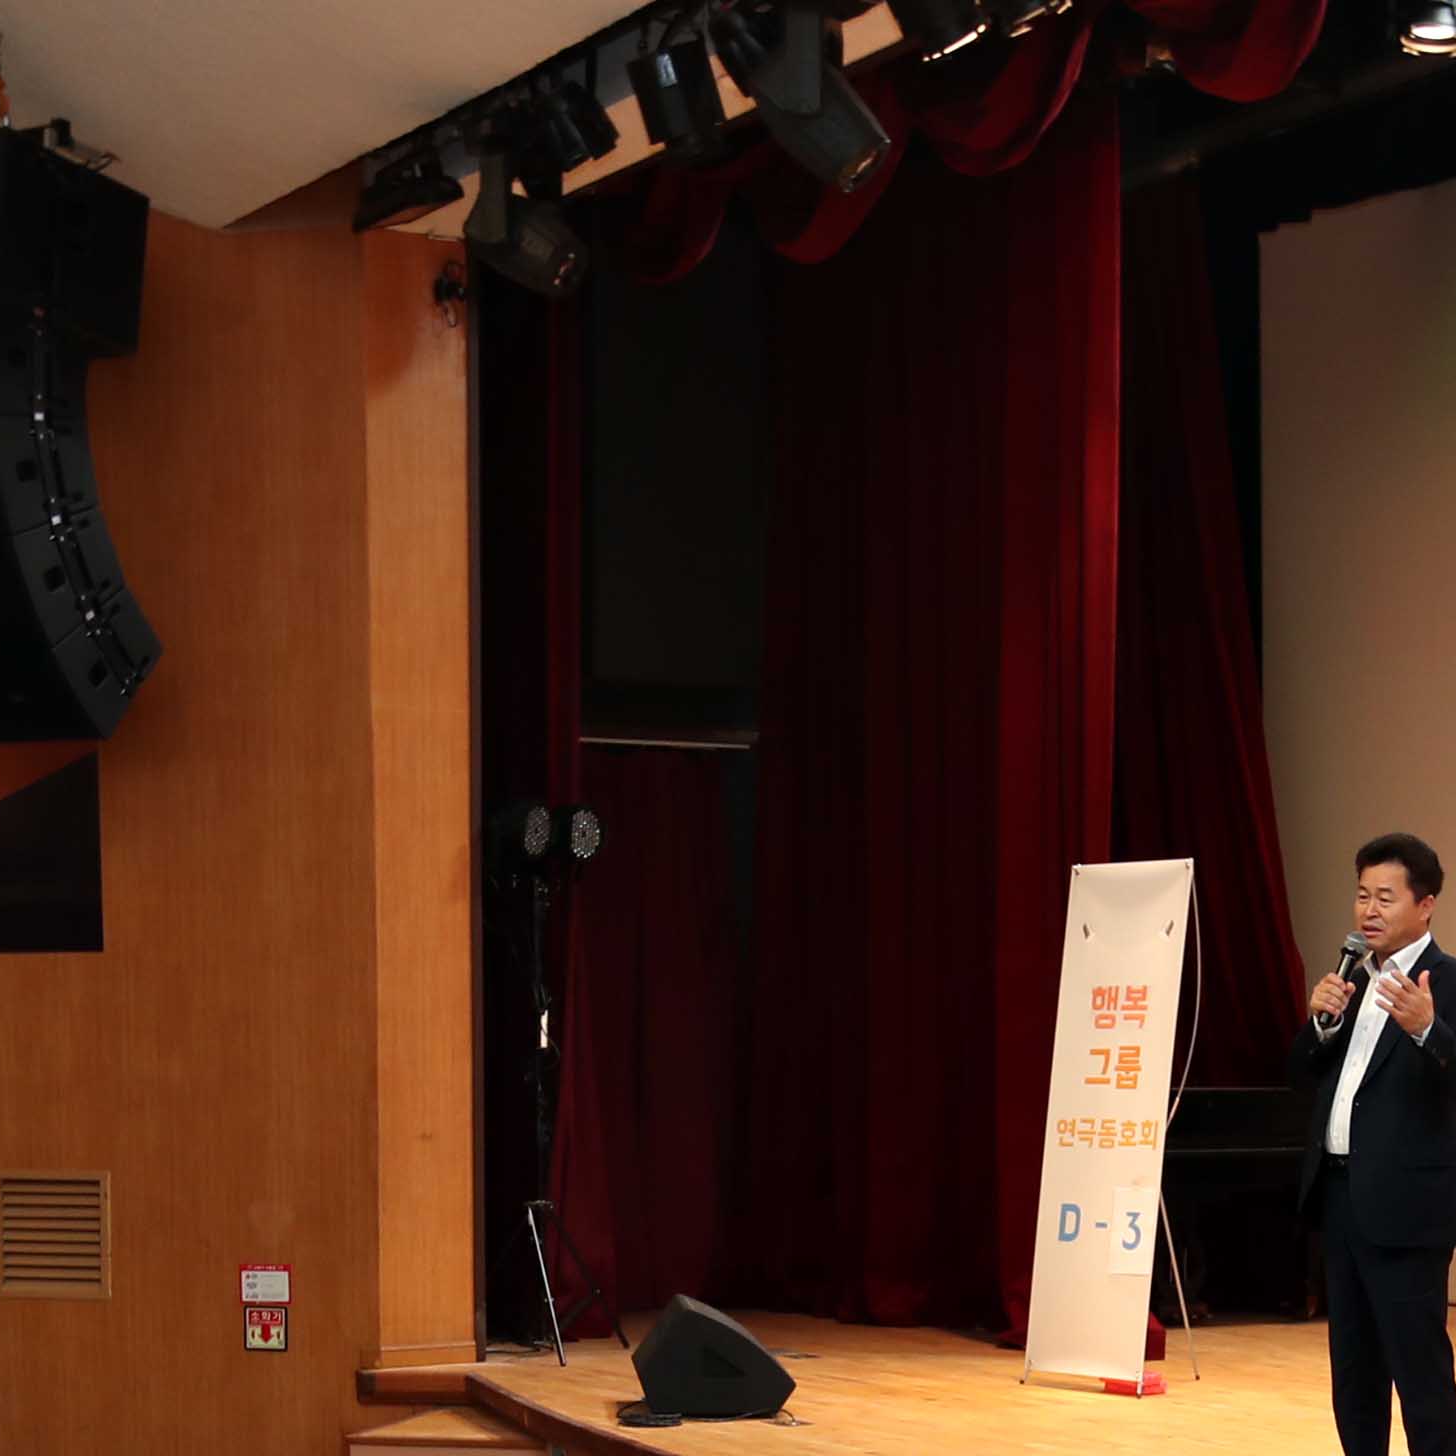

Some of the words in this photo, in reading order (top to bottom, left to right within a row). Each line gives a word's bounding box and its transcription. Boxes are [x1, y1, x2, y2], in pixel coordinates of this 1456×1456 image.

[1091, 984, 1150, 1029] 행복
[1084, 1045, 1142, 1089] 그룹
[1056, 1118, 1160, 1150] 연극동호회
